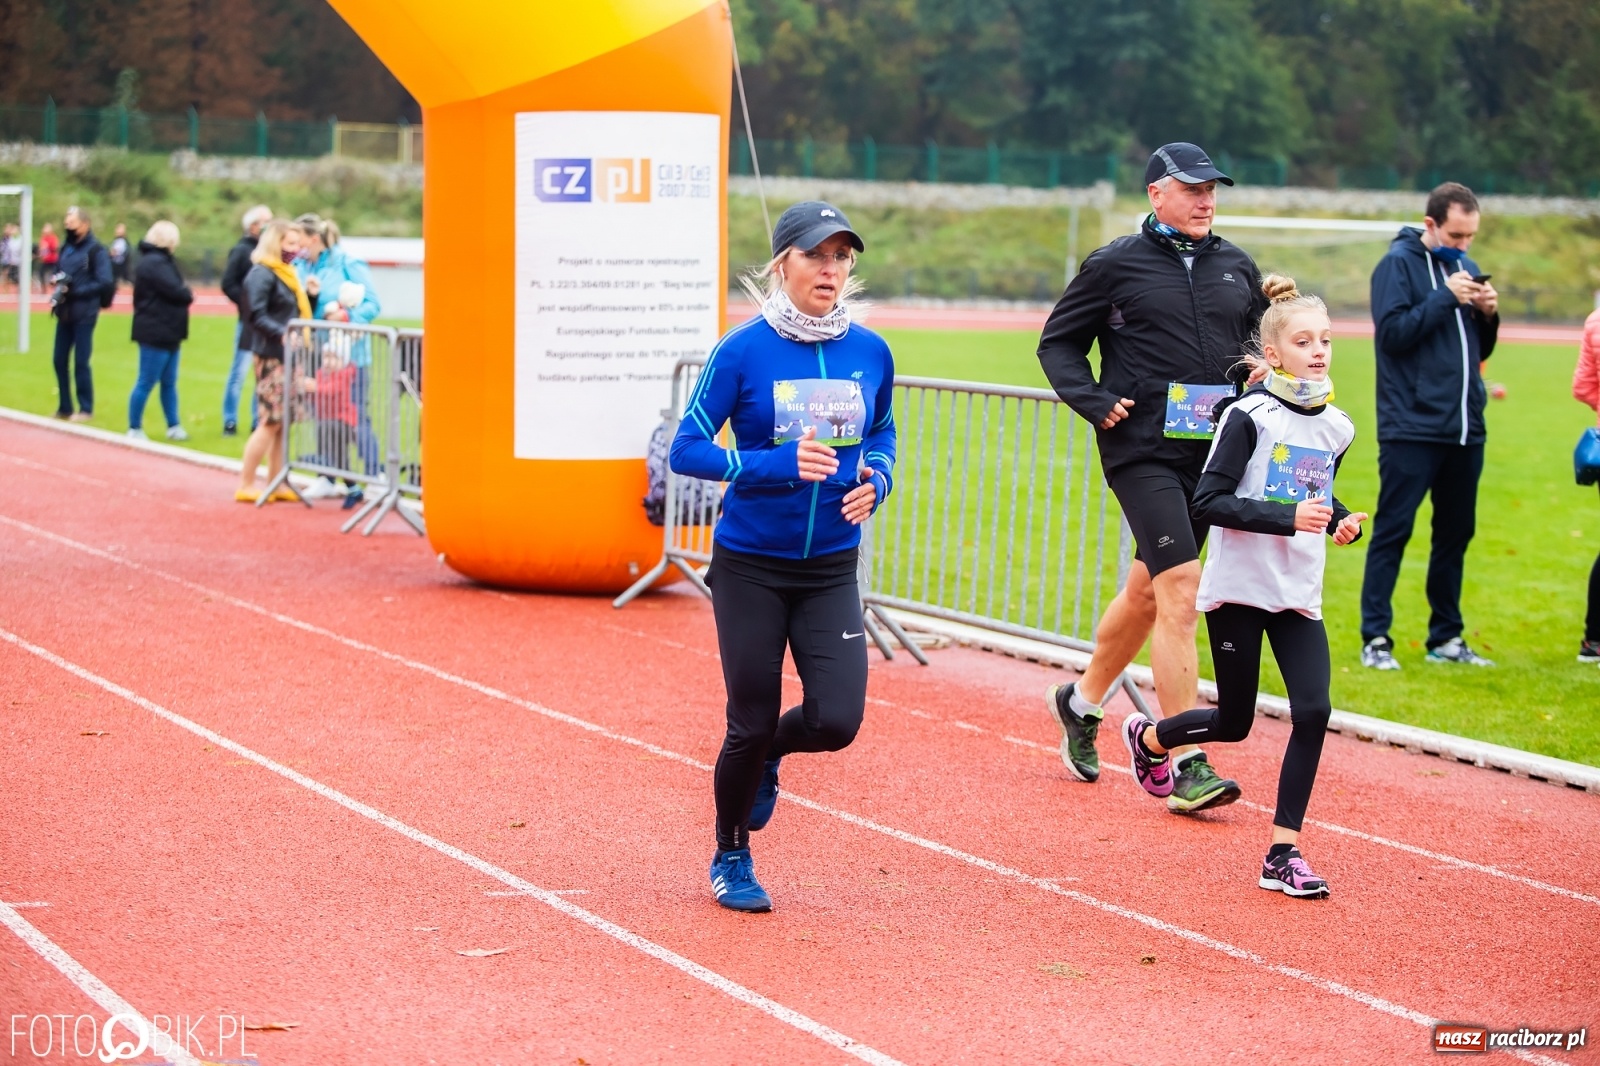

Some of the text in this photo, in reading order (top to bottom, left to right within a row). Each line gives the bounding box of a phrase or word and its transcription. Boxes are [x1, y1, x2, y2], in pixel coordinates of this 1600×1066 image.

[606, 158, 643, 203] pl
[786, 403, 805, 412] BIEG
[809, 402, 825, 412] DLA
[1177, 403, 1192, 411] BIEG
[1195, 404, 1207, 412] DLA
[831, 424, 857, 437] 115
[1278, 465, 1293, 474] BIEG
[1296, 468, 1307, 476] DLA
